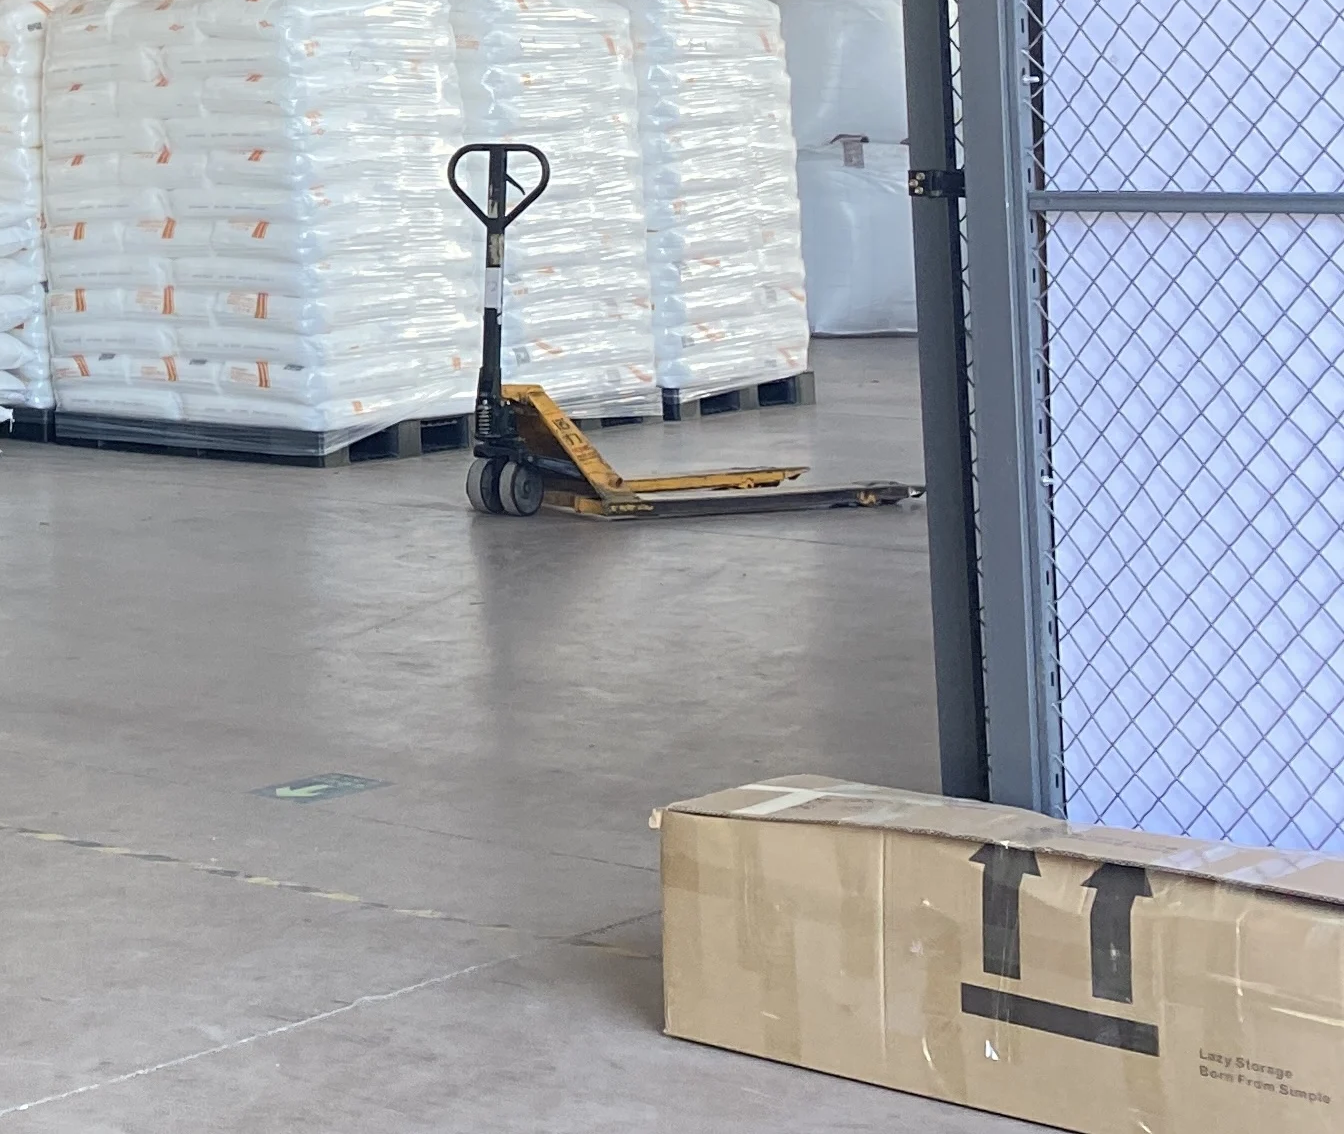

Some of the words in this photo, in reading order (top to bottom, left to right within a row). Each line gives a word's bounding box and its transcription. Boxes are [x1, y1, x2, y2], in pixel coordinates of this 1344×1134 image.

[1199, 1047, 1232, 1068] Lazy
[1235, 1057, 1293, 1080] Storage
[1199, 1065, 1234, 1083] Born
[1237, 1074, 1275, 1092] From
[1279, 1083, 1331, 1104] Simple
